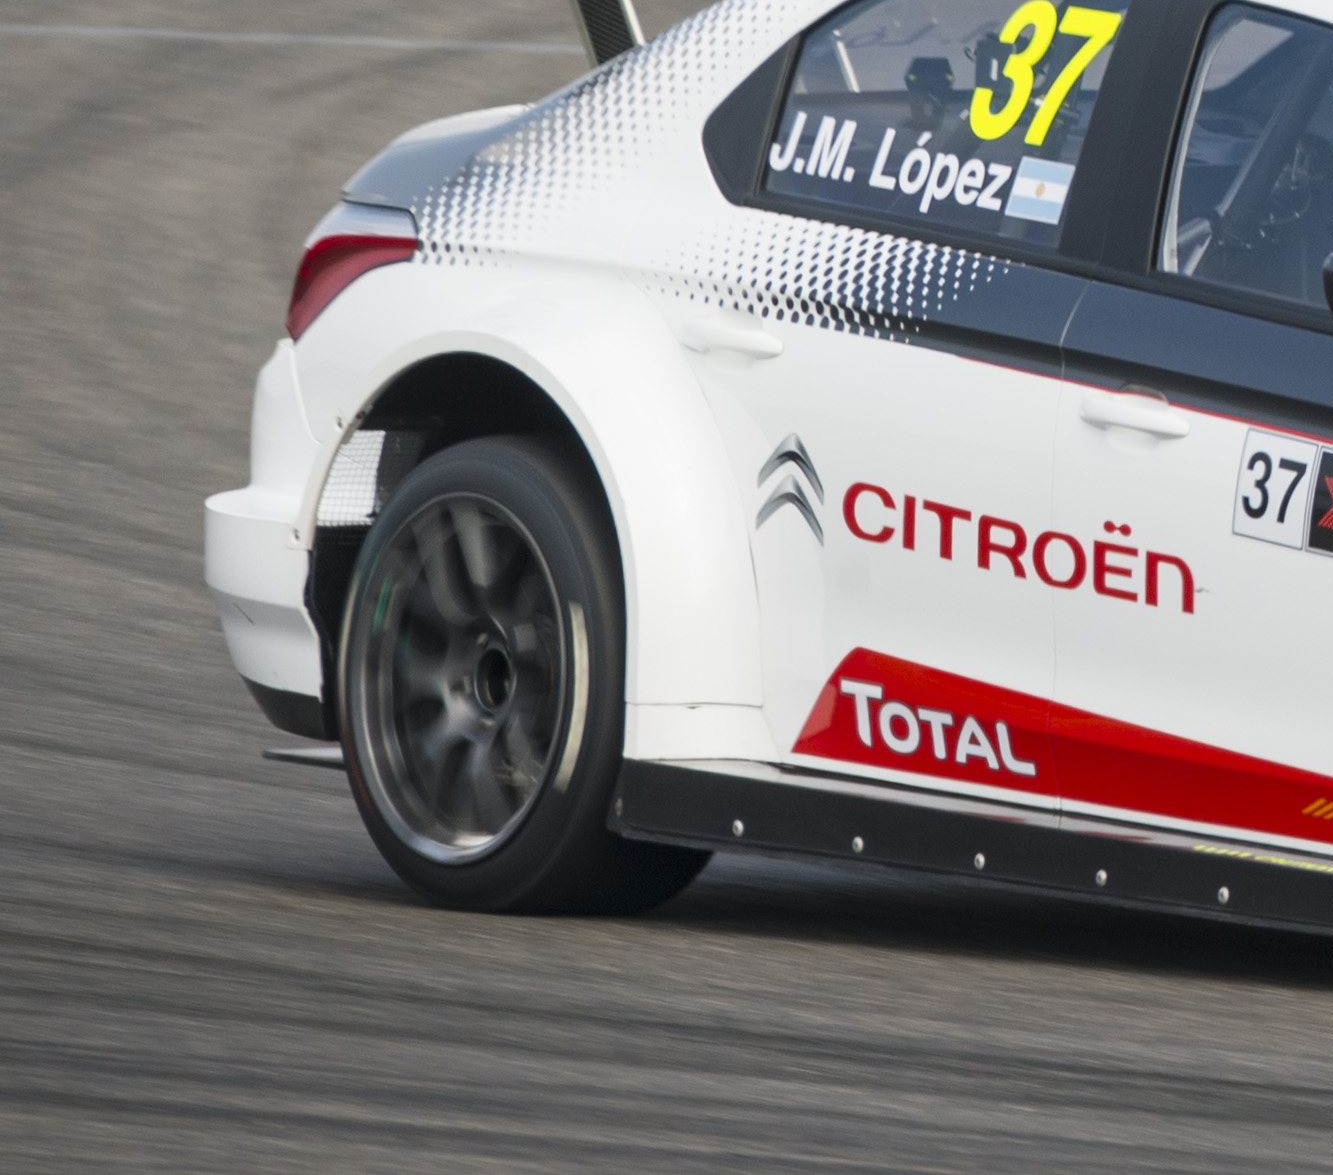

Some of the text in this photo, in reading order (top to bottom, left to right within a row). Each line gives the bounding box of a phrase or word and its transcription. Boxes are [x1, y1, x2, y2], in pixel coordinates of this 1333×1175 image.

[769, 110, 1014, 213] J.M. López
[1241, 450, 1308, 525] 37
[842, 481, 1195, 614] CITROËN
[841, 678, 1037, 777] TOTAL
